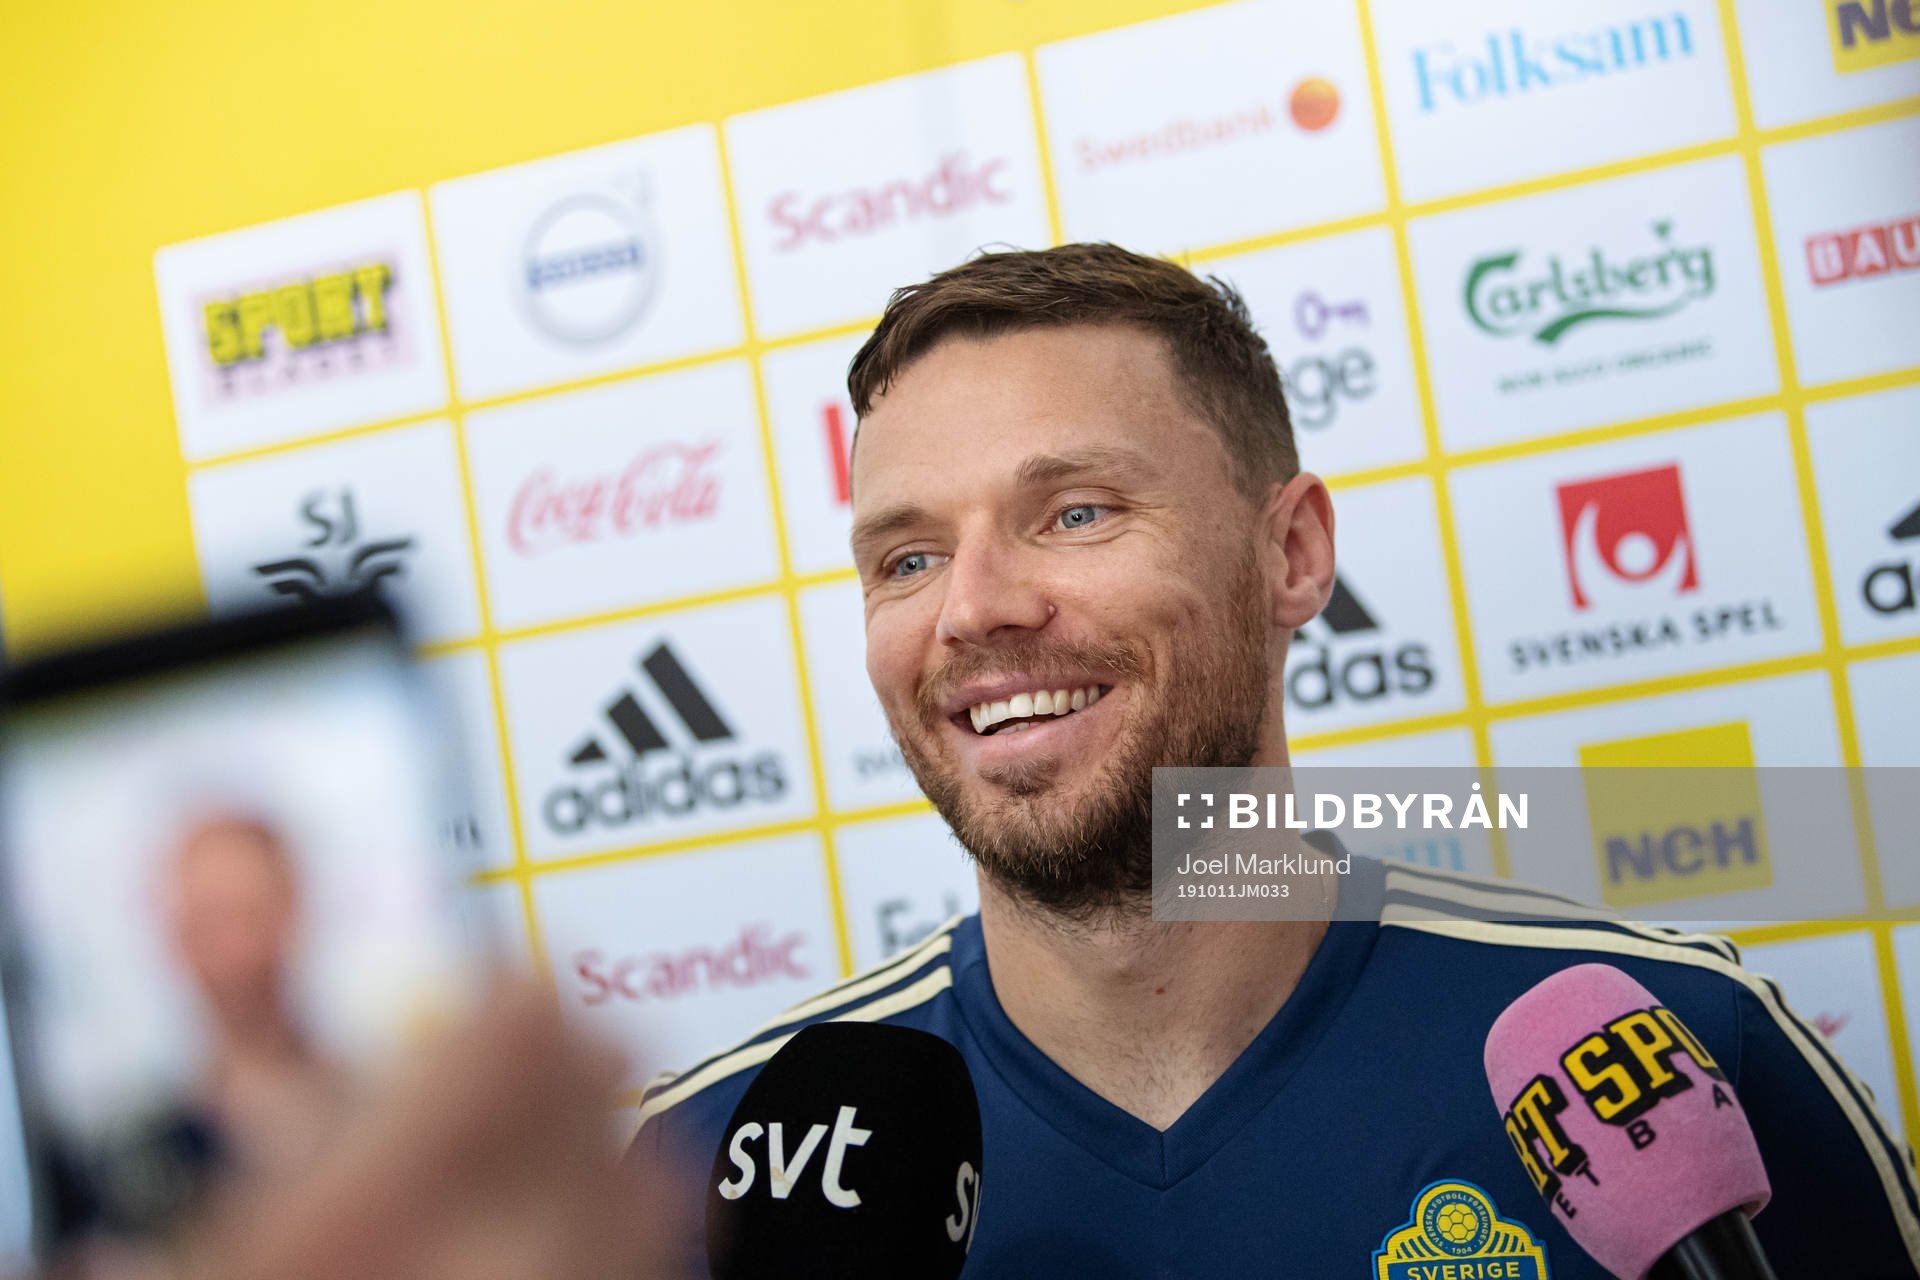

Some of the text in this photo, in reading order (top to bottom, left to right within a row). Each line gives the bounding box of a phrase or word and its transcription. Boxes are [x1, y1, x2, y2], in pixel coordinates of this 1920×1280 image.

[1413, 12, 1695, 112] Folksam
[1073, 105, 1276, 172] Swedbank
[767, 152, 1012, 250] Scandic
[203, 262, 392, 368] SPORT
[1463, 246, 1716, 342] Carlsberg
[1510, 599, 1784, 673] SVENSKA SPEL
[543, 749, 787, 836] adidas
[574, 930, 808, 1004] Scandic
[718, 1105, 872, 1208] svt
[1407, 1261, 1521, 1280] SVERIGE
